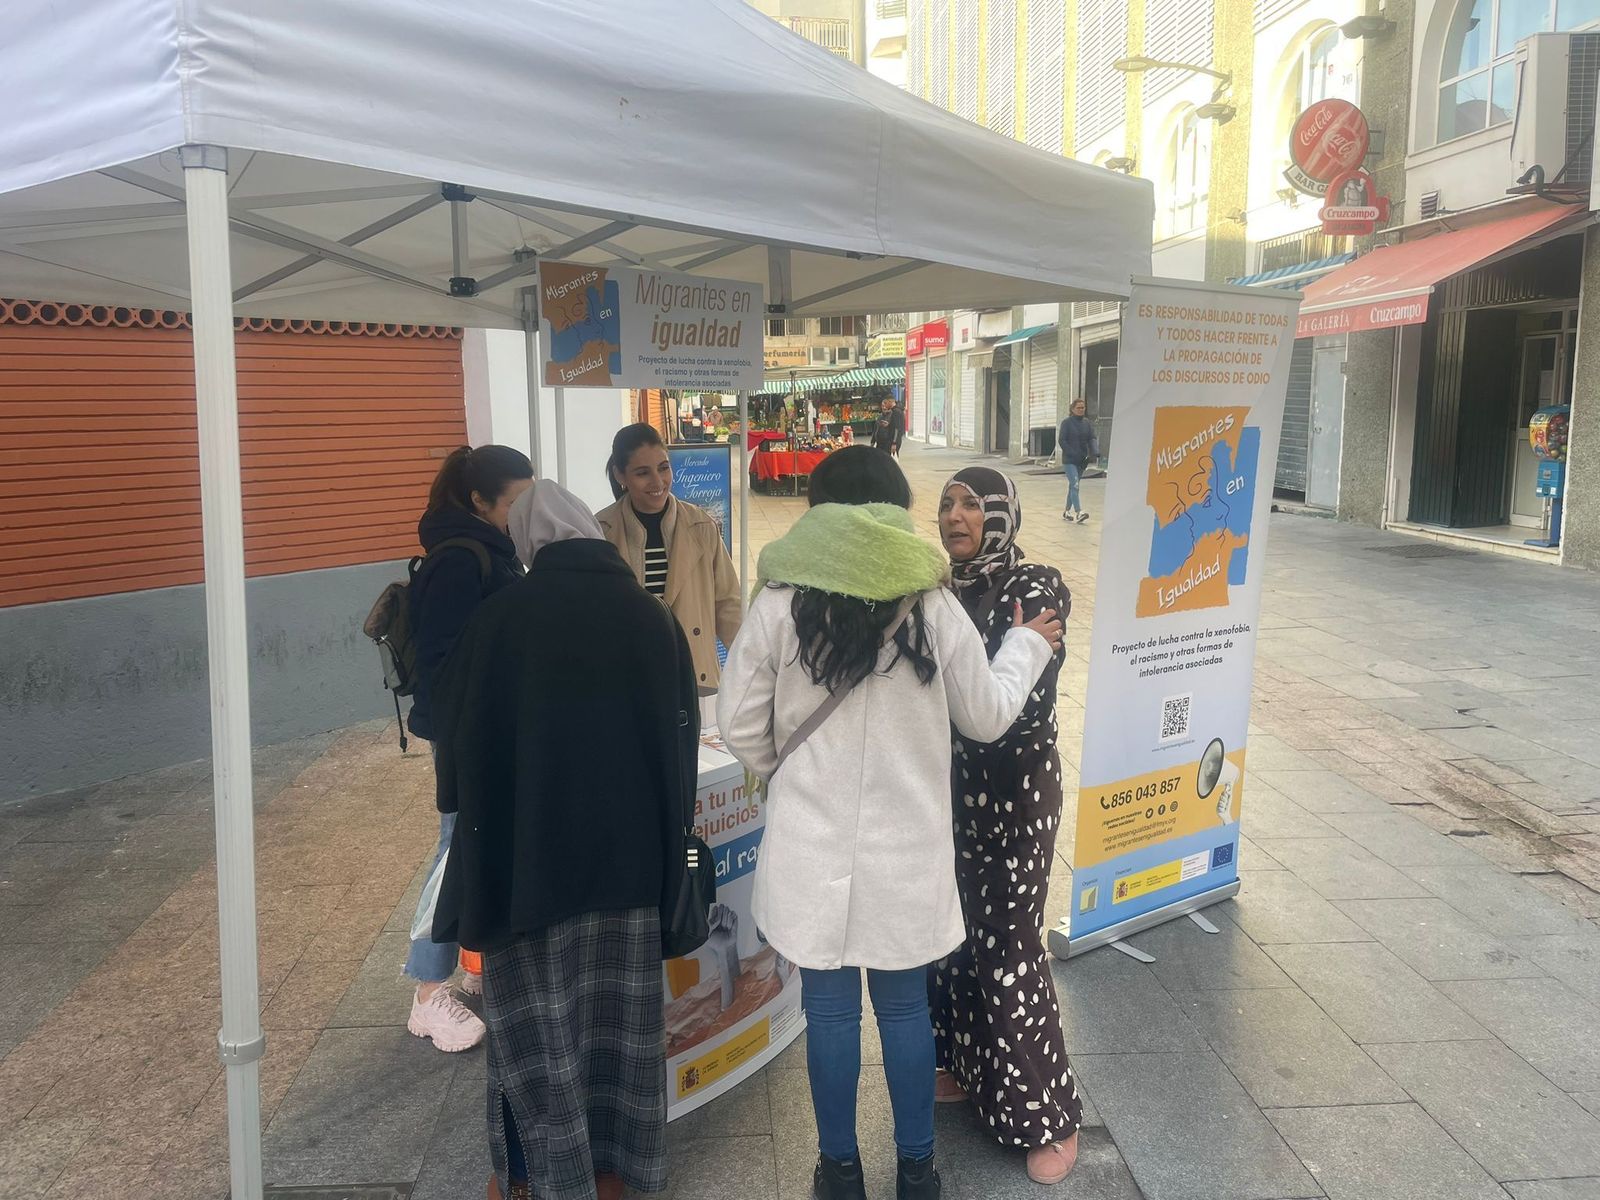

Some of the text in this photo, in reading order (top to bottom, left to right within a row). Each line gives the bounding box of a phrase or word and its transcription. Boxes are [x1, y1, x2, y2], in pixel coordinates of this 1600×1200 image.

[1300, 105, 1333, 146] Coca-Cola
[1294, 171, 1316, 192] BAR
[1326, 208, 1376, 220] Cruzcampo
[545, 270, 599, 300] Migrantes
[635, 273, 751, 313] Migrantes en
[599, 307, 613, 320] en
[1138, 304, 1289, 328] ES RESPONSABILIDAD DE TODAS
[1298, 310, 1350, 333] LA GALERÍA
[1370, 303, 1421, 324] Cruzcampo
[651, 314, 742, 351] igualdad
[924, 336, 945, 344] suma
[1157, 327, 1278, 346] Y TODOS HACER FRENTE A
[638, 355, 668, 365] Proyecto
[669, 356, 677, 365] de
[679, 356, 695, 365] lucha
[697, 357, 716, 366] contra
[717, 358, 723, 366] la
[1163, 348, 1262, 365] LA PROPAGACIÓN DE
[559, 354, 604, 383] Igualdad
[655, 367, 661, 375] el
[662, 368, 688, 376] racismo
[710, 368, 731, 376] formas
[732, 369, 740, 377] de
[1152, 369, 1271, 385] LOS DISCURSOS DE ODIO
[664, 378, 732, 387] intolerancia asociadas
[1156, 413, 1235, 474] Migrantes
[681, 455, 710, 467] Mercado
[672, 467, 722, 488] Ingeniero
[1226, 474, 1245, 496] en
[684, 484, 722, 503] Torroja
[1156, 553, 1221, 609] Igualdad
[1112, 623, 1251, 655] Proyecto de lucha contra la xenofobia,
[1130, 638, 1233, 666] el racismo y otras formas de
[1139, 655, 1223, 678] intolerancia asociadas
[708, 791, 726, 810] tu
[1111, 776, 1181, 808] 856 043 857
[715, 848, 731, 878] al
